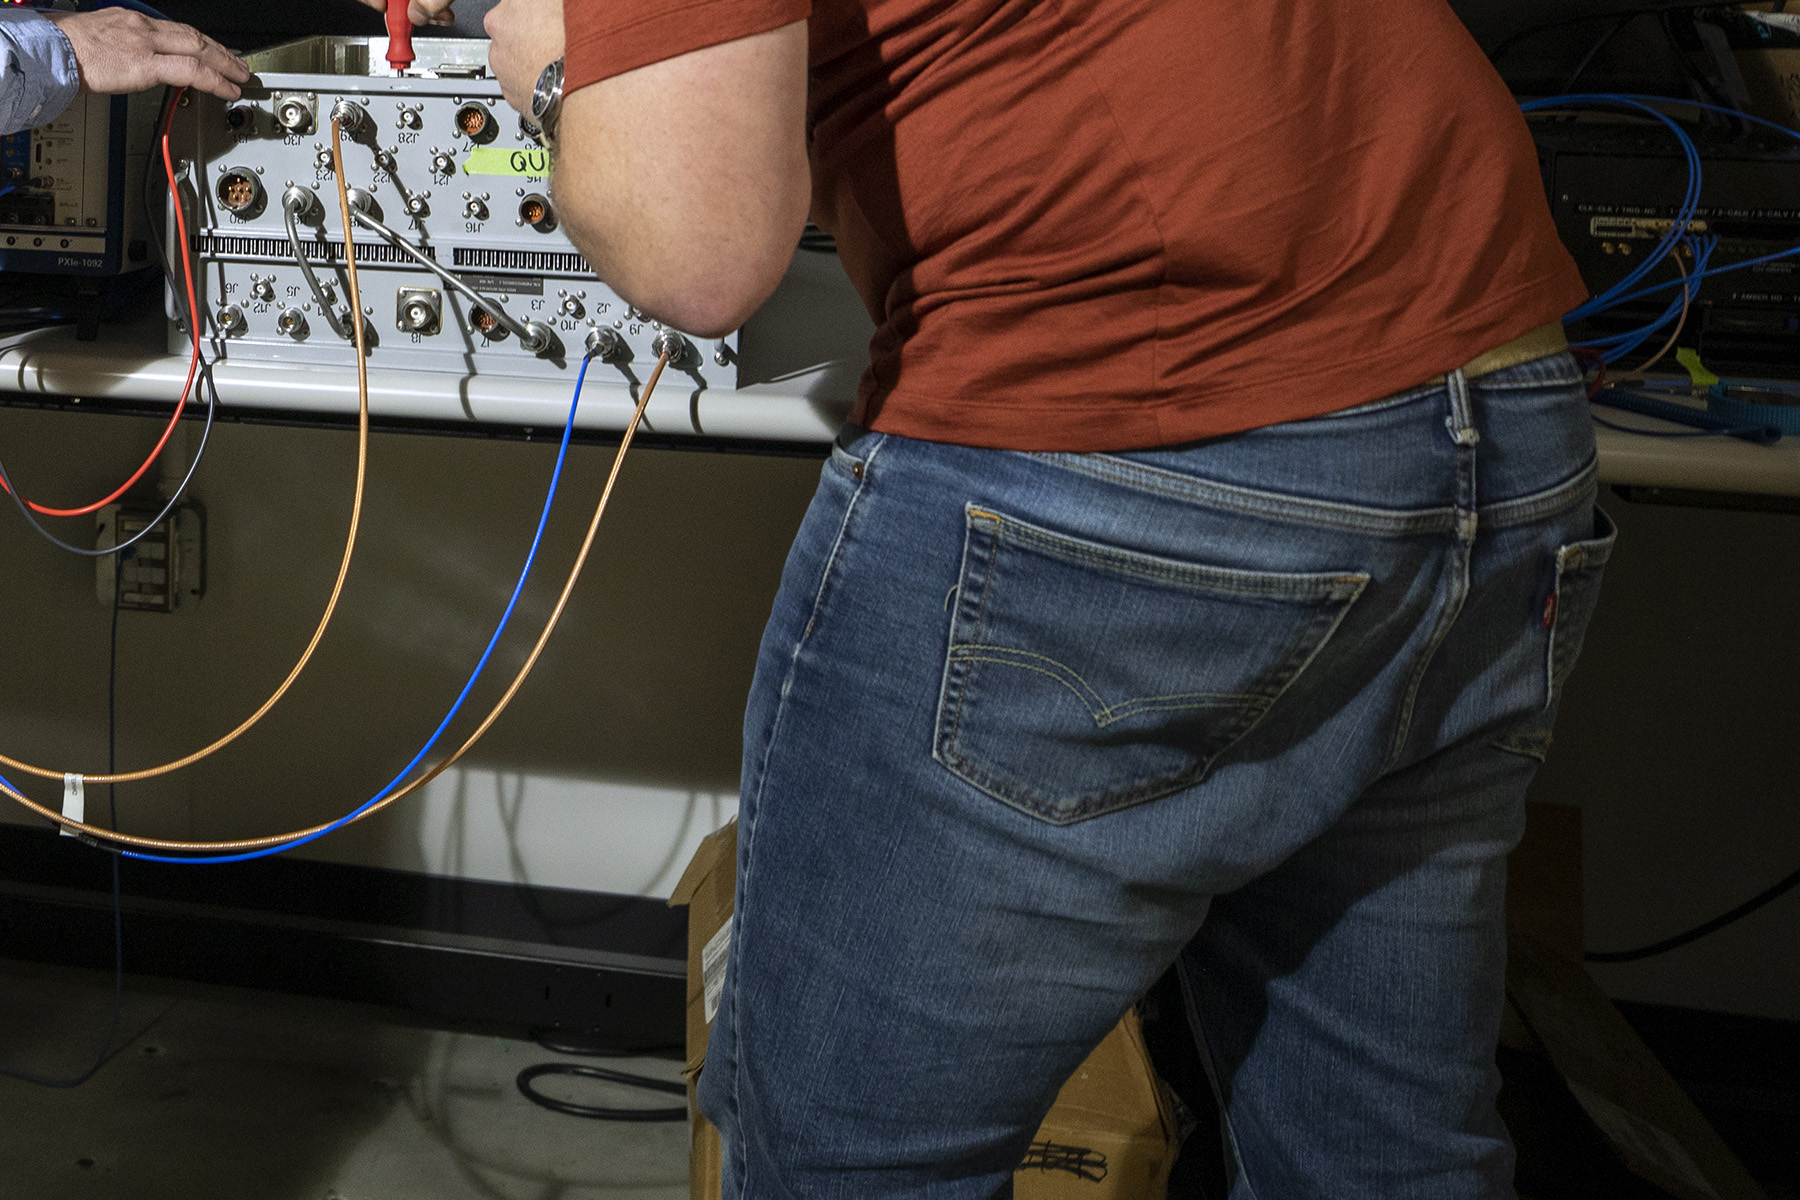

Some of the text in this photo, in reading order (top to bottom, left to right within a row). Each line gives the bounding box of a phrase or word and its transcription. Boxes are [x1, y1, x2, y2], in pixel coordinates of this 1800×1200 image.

[284, 135, 305, 146] J30
[398, 133, 420, 144] J28
[315, 170, 335, 181] J23
[373, 172, 392, 183] J22
[433, 174, 452, 186] J21
[408, 219, 426, 231] J17
[465, 222, 485, 233] J16
[57, 257, 103, 269] PXIe-1092
[225, 282, 239, 294] J6
[287, 285, 300, 297] J5
[253, 302, 272, 313] J12
[531, 299, 545, 310] J3
[597, 302, 611, 314] J2
[560, 319, 581, 331] J10
[629, 323, 644, 335] J9
[411, 332, 424, 343] J8
[481, 337, 490, 347] J7
